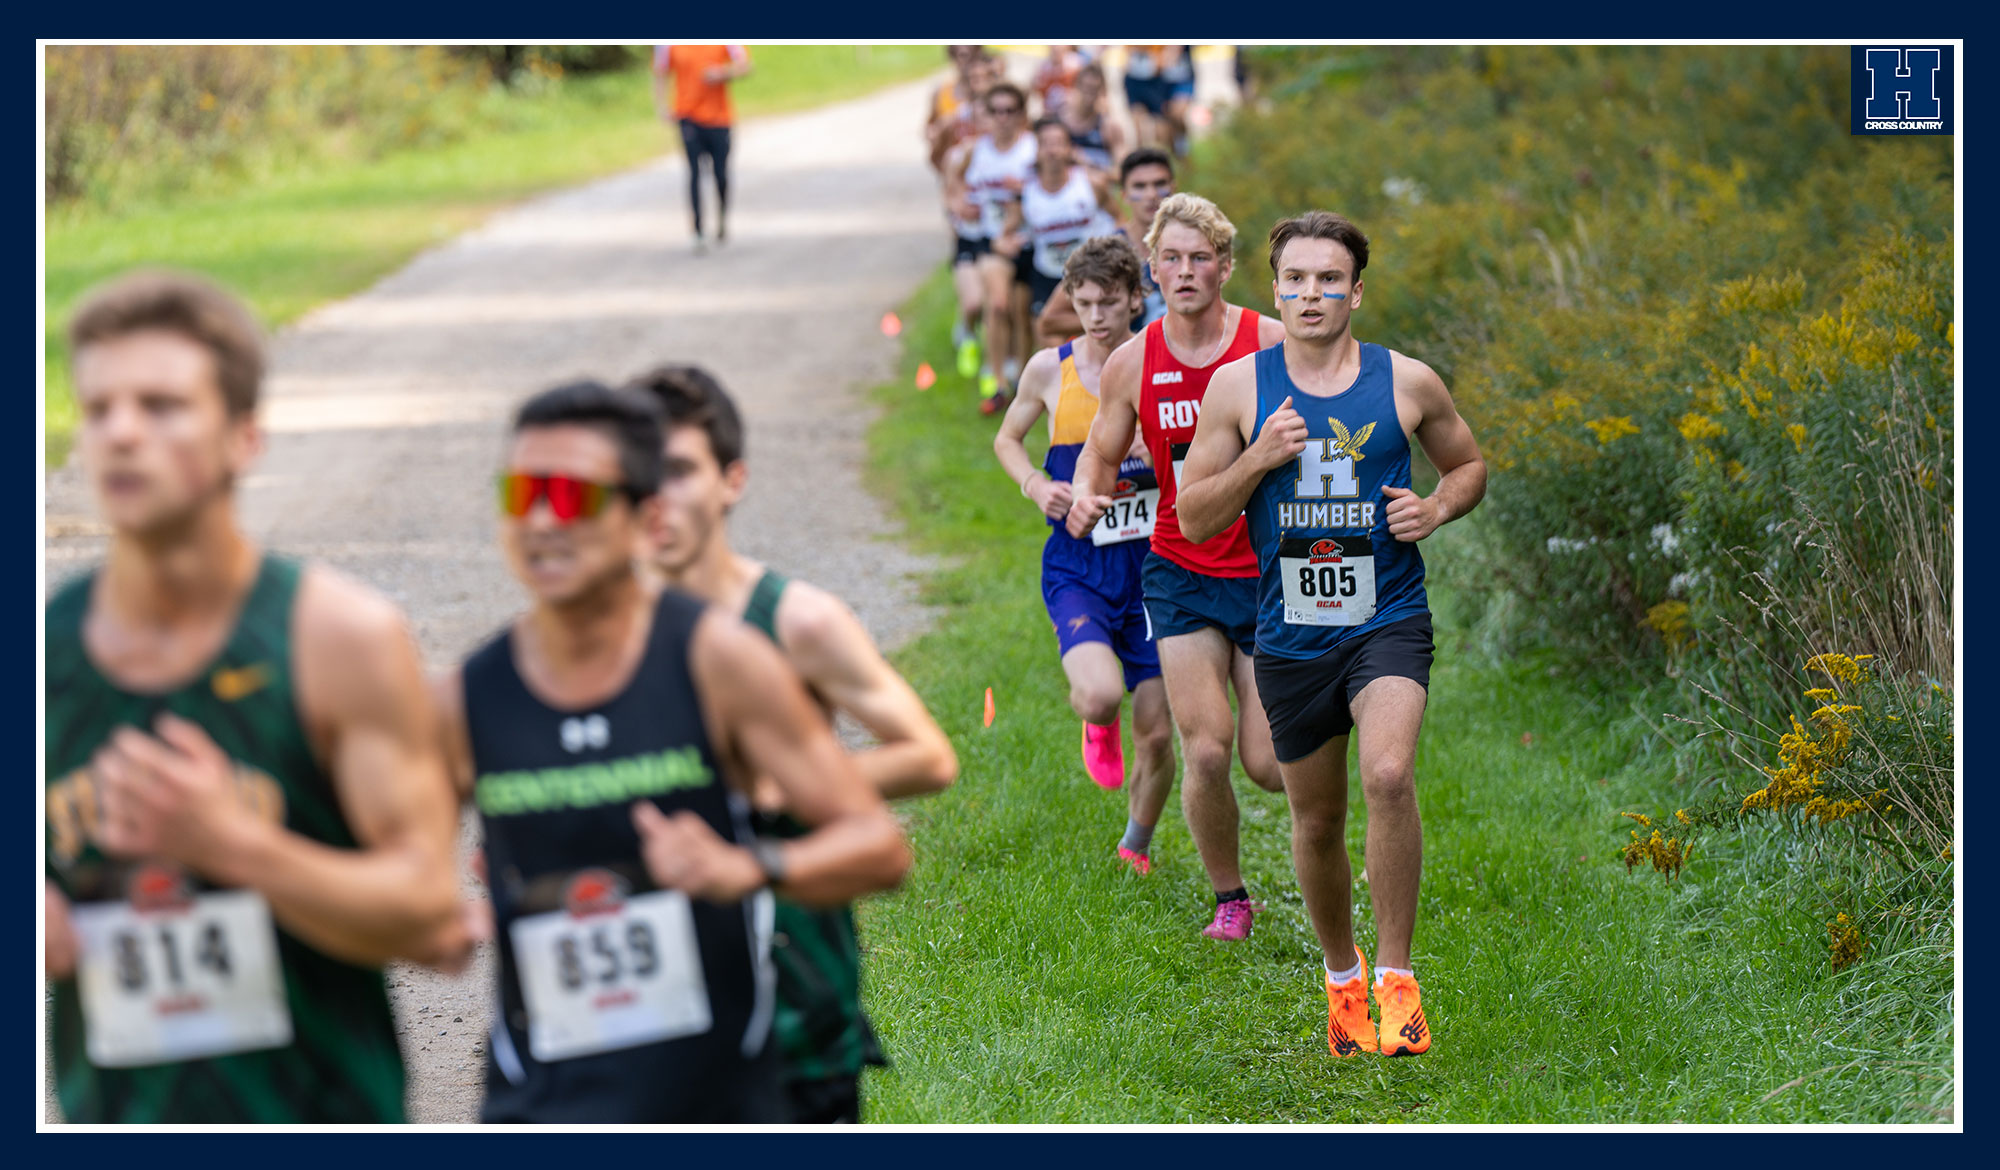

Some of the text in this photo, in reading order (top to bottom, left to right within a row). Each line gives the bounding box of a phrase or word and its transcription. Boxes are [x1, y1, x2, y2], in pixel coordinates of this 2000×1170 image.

[1152, 371, 1183, 385] OCAA
[1104, 498, 1148, 529] 874
[1278, 502, 1376, 528] HUMBER
[1299, 566, 1357, 597] 805
[1316, 600, 1342, 608] OCAA
[112, 918, 235, 994] 814
